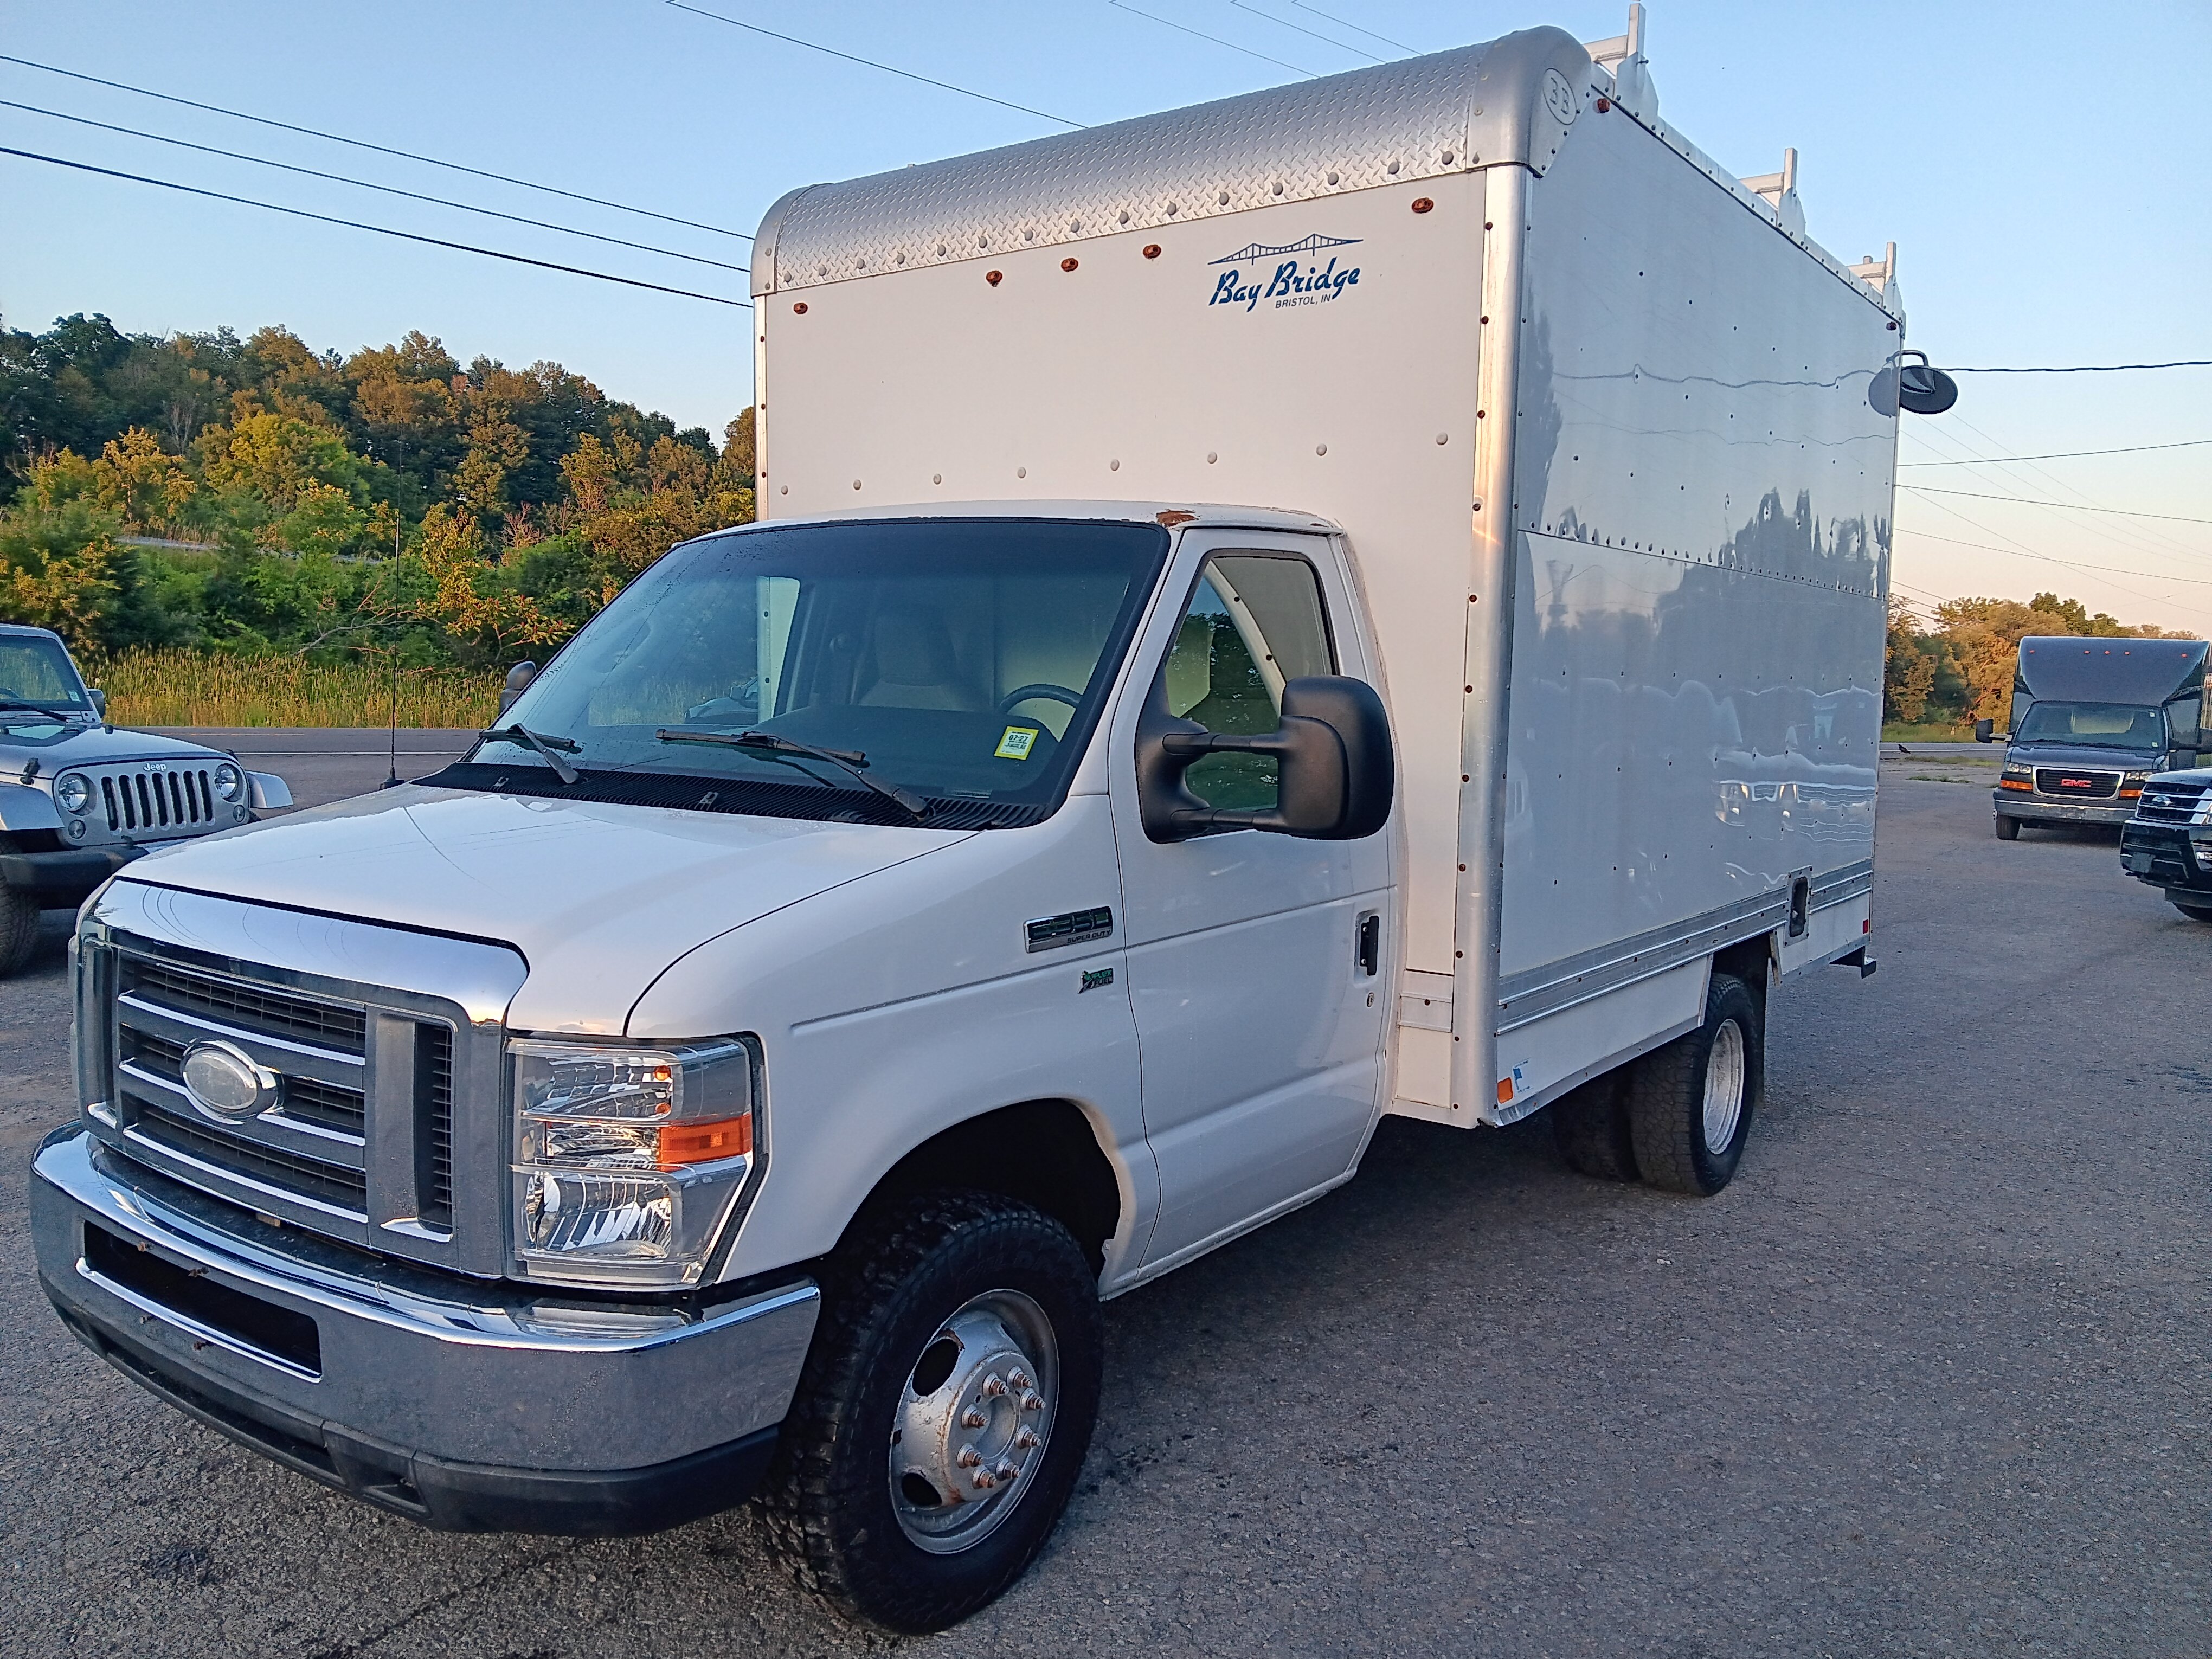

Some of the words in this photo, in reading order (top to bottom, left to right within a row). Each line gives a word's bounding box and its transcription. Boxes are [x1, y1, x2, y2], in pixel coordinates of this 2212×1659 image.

[1208, 269, 1263, 313] Bay
[1264, 256, 1361, 300] Bridge
[1275, 297, 1318, 309] BRISTOL,
[1321, 294, 1331, 303] IN
[143, 762, 166, 771] Jeep
[2061, 779, 2092, 788] GMC
[1066, 934, 1090, 944] SUPER
[1091, 929, 1111, 939] DUTY
[1093, 969, 1112, 980] FLEX
[1094, 977, 1112, 988] FUEL
